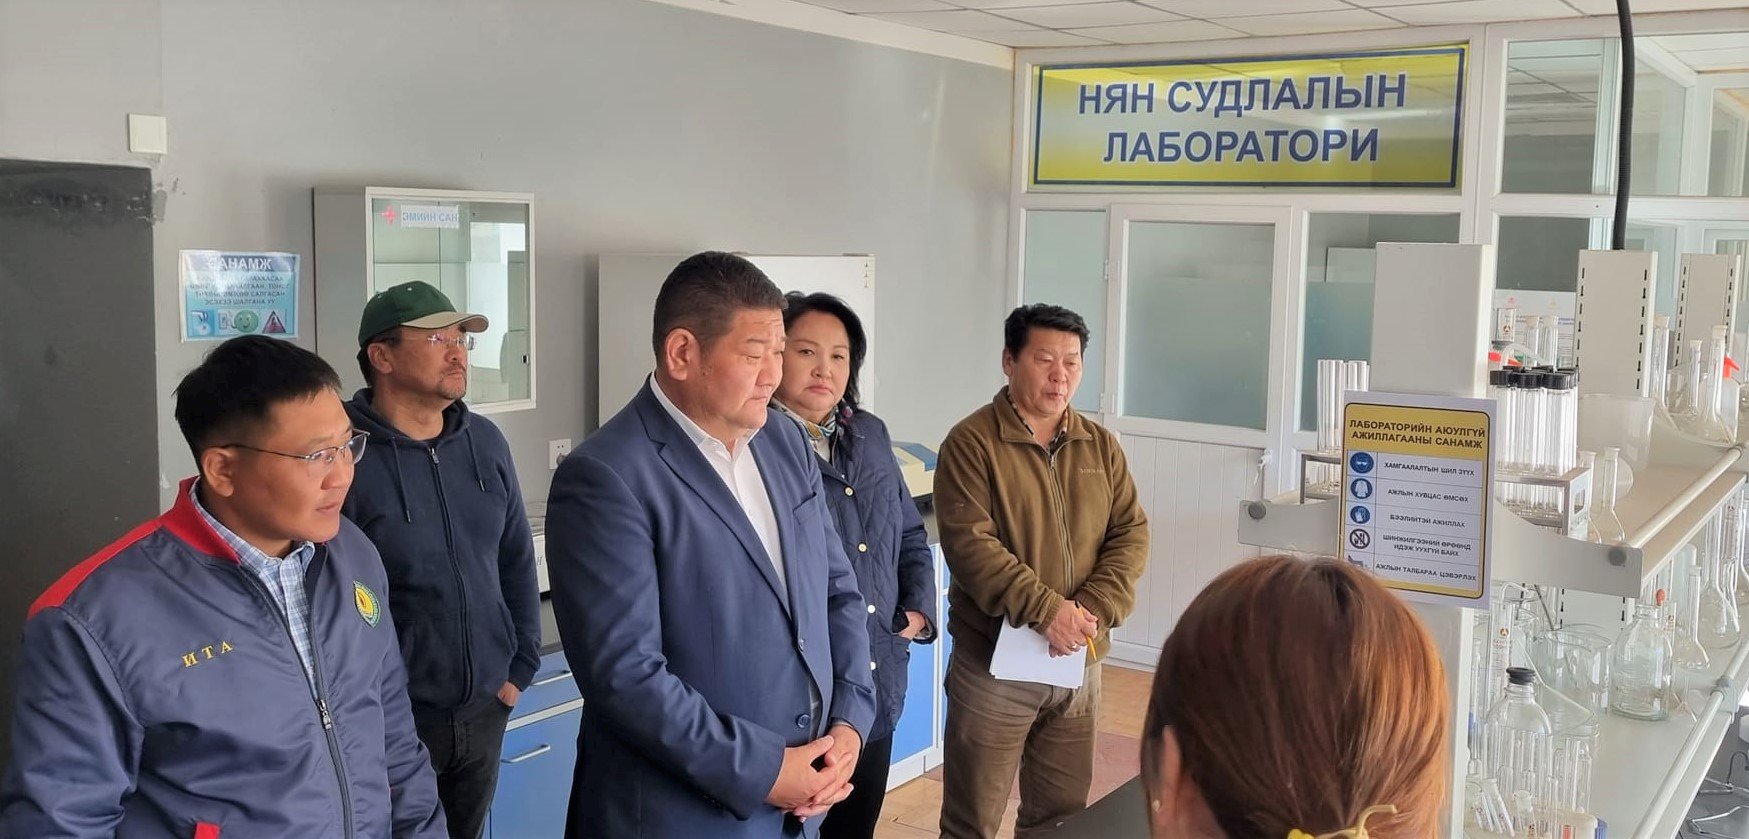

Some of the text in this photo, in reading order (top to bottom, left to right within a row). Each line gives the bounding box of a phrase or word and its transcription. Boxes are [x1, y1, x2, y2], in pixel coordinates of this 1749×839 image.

[1078, 73, 1406, 118] НЯН СУДЛАЛЫН
[1103, 128, 1379, 163] ЛАБОРАТОРИ
[438, 213, 458, 222] САН
[208, 257, 272, 270] САНАМЖ
[1349, 419, 1486, 438] ЛАБОРАТОРИЙН АЮУЛГҮЙ
[1352, 431, 1483, 449] АЖИЛЛАГААНЫ САНАМЖ
[1384, 462, 1439, 474] ХАМГААЛАЛТЫН
[1387, 488, 1414, 497] АЖЛЫН
[1415, 491, 1442, 500] ХУВЦАС
[1389, 513, 1466, 528] БЭЭЛИЙТЭЙ АЖИЛЛАХ
[1382, 534, 1440, 547] ШИНЖИЛГЭЭНИЙ
[1393, 544, 1414, 552] ИДЭЖ
[1440, 549, 1460, 557] БАЙХ
[1375, 563, 1477, 582] АЖЛЫН ТАЛБАРАА ЦЭВЭРЛЭХ
[181, 640, 234, 668] ИТА
